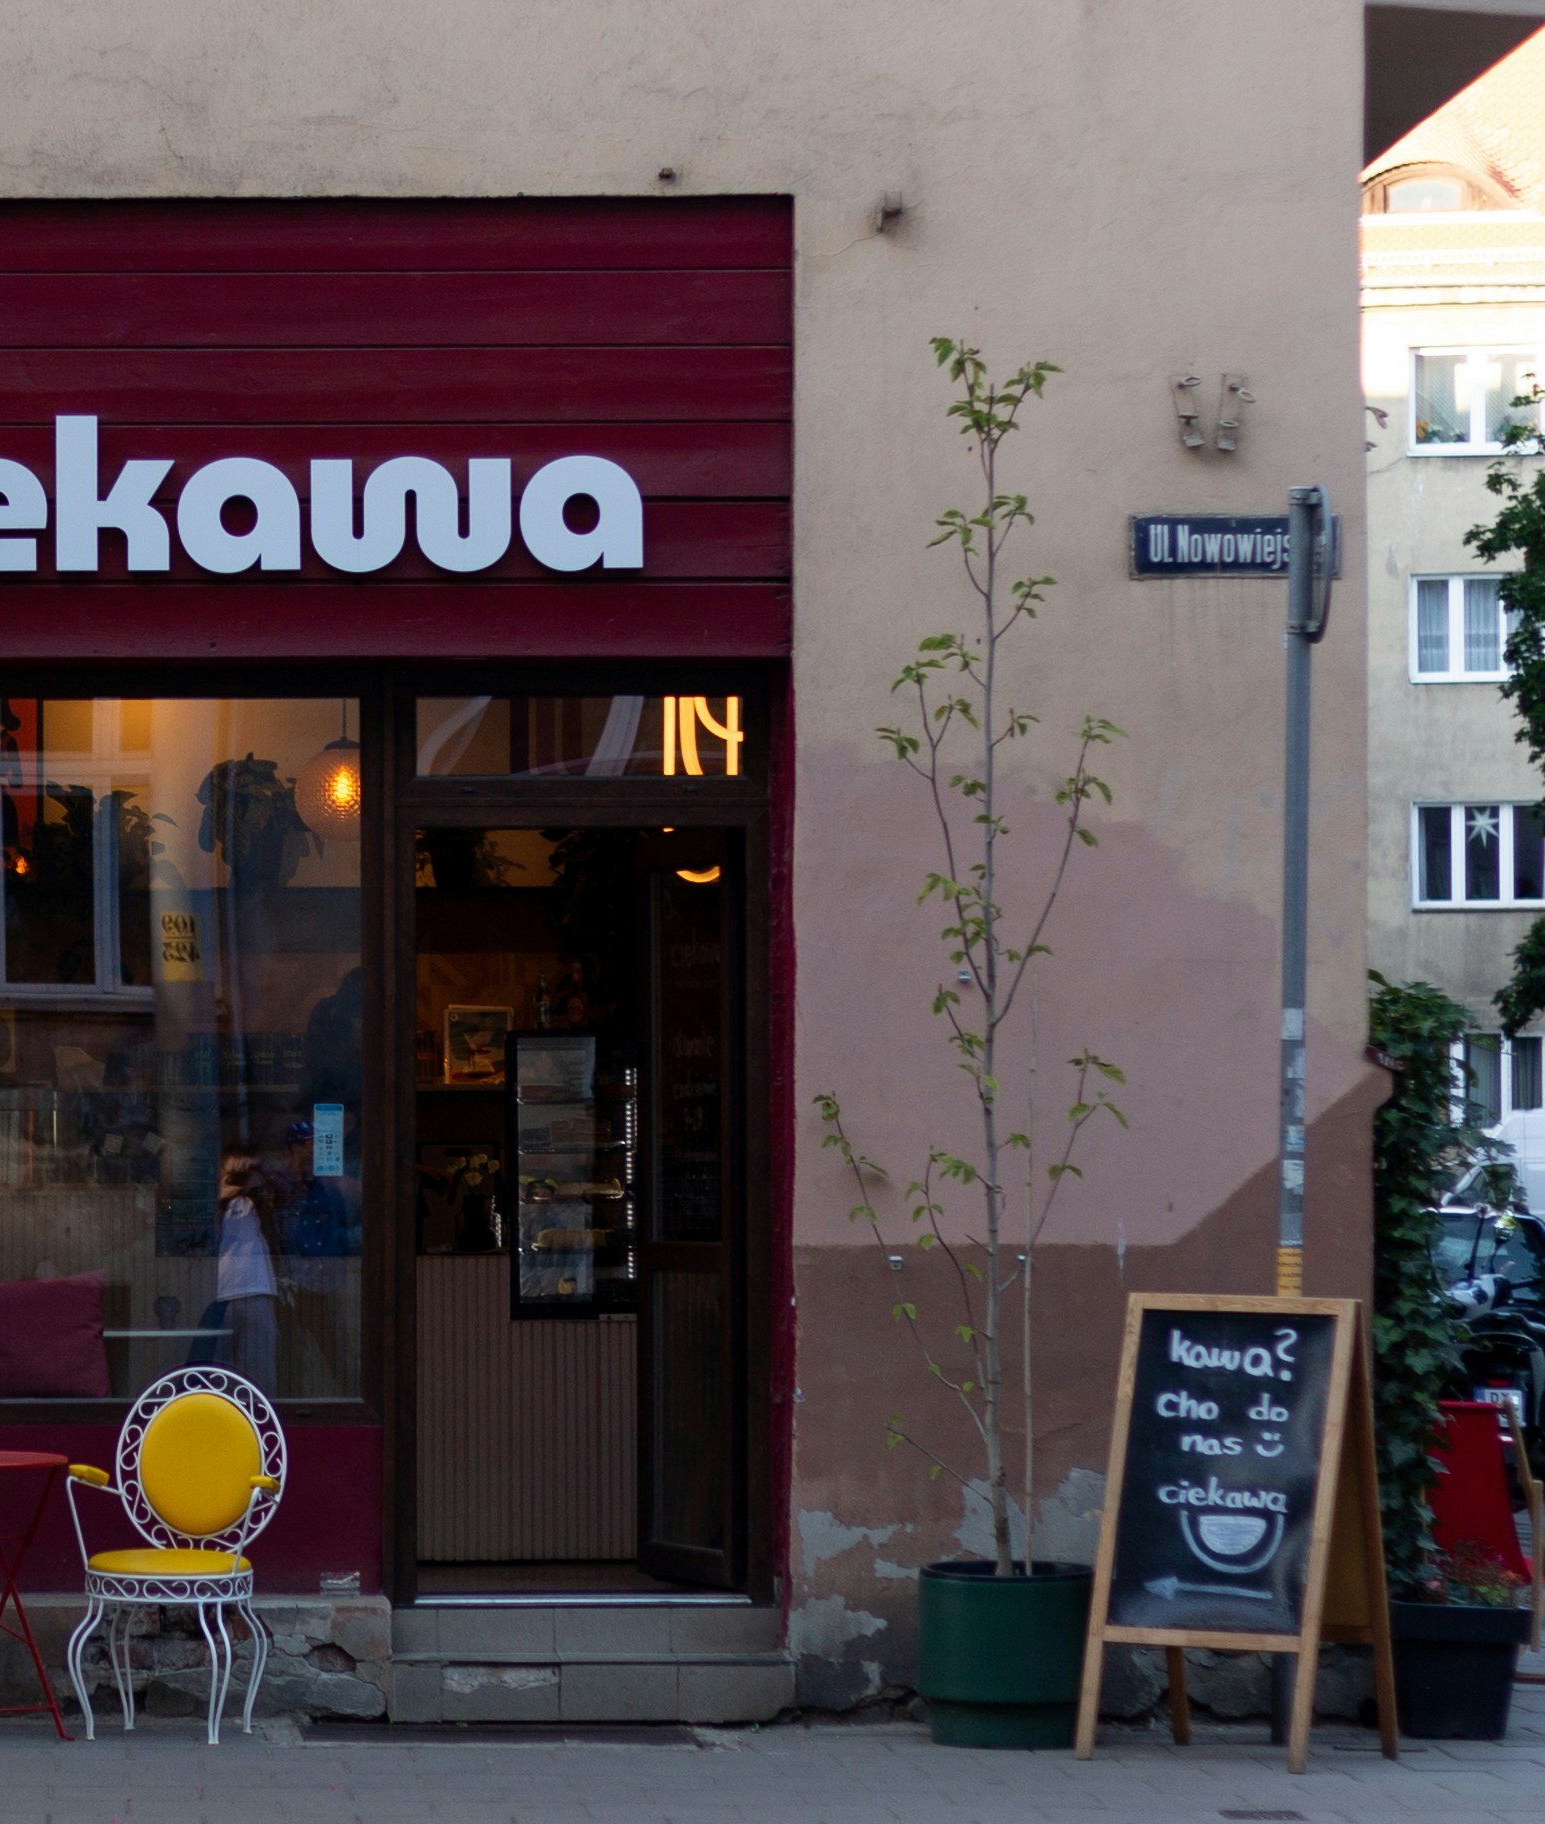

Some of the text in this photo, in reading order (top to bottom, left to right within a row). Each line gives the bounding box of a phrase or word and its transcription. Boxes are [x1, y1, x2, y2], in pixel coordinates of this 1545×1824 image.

[1177, 524, 1291, 569] Nowowiejs
[1170, 1328, 1298, 1381] kawa?
[1248, 1392, 1289, 1422] do
[1181, 1433, 1243, 1455] nas
[1158, 1476, 1288, 1513] ciekawa
